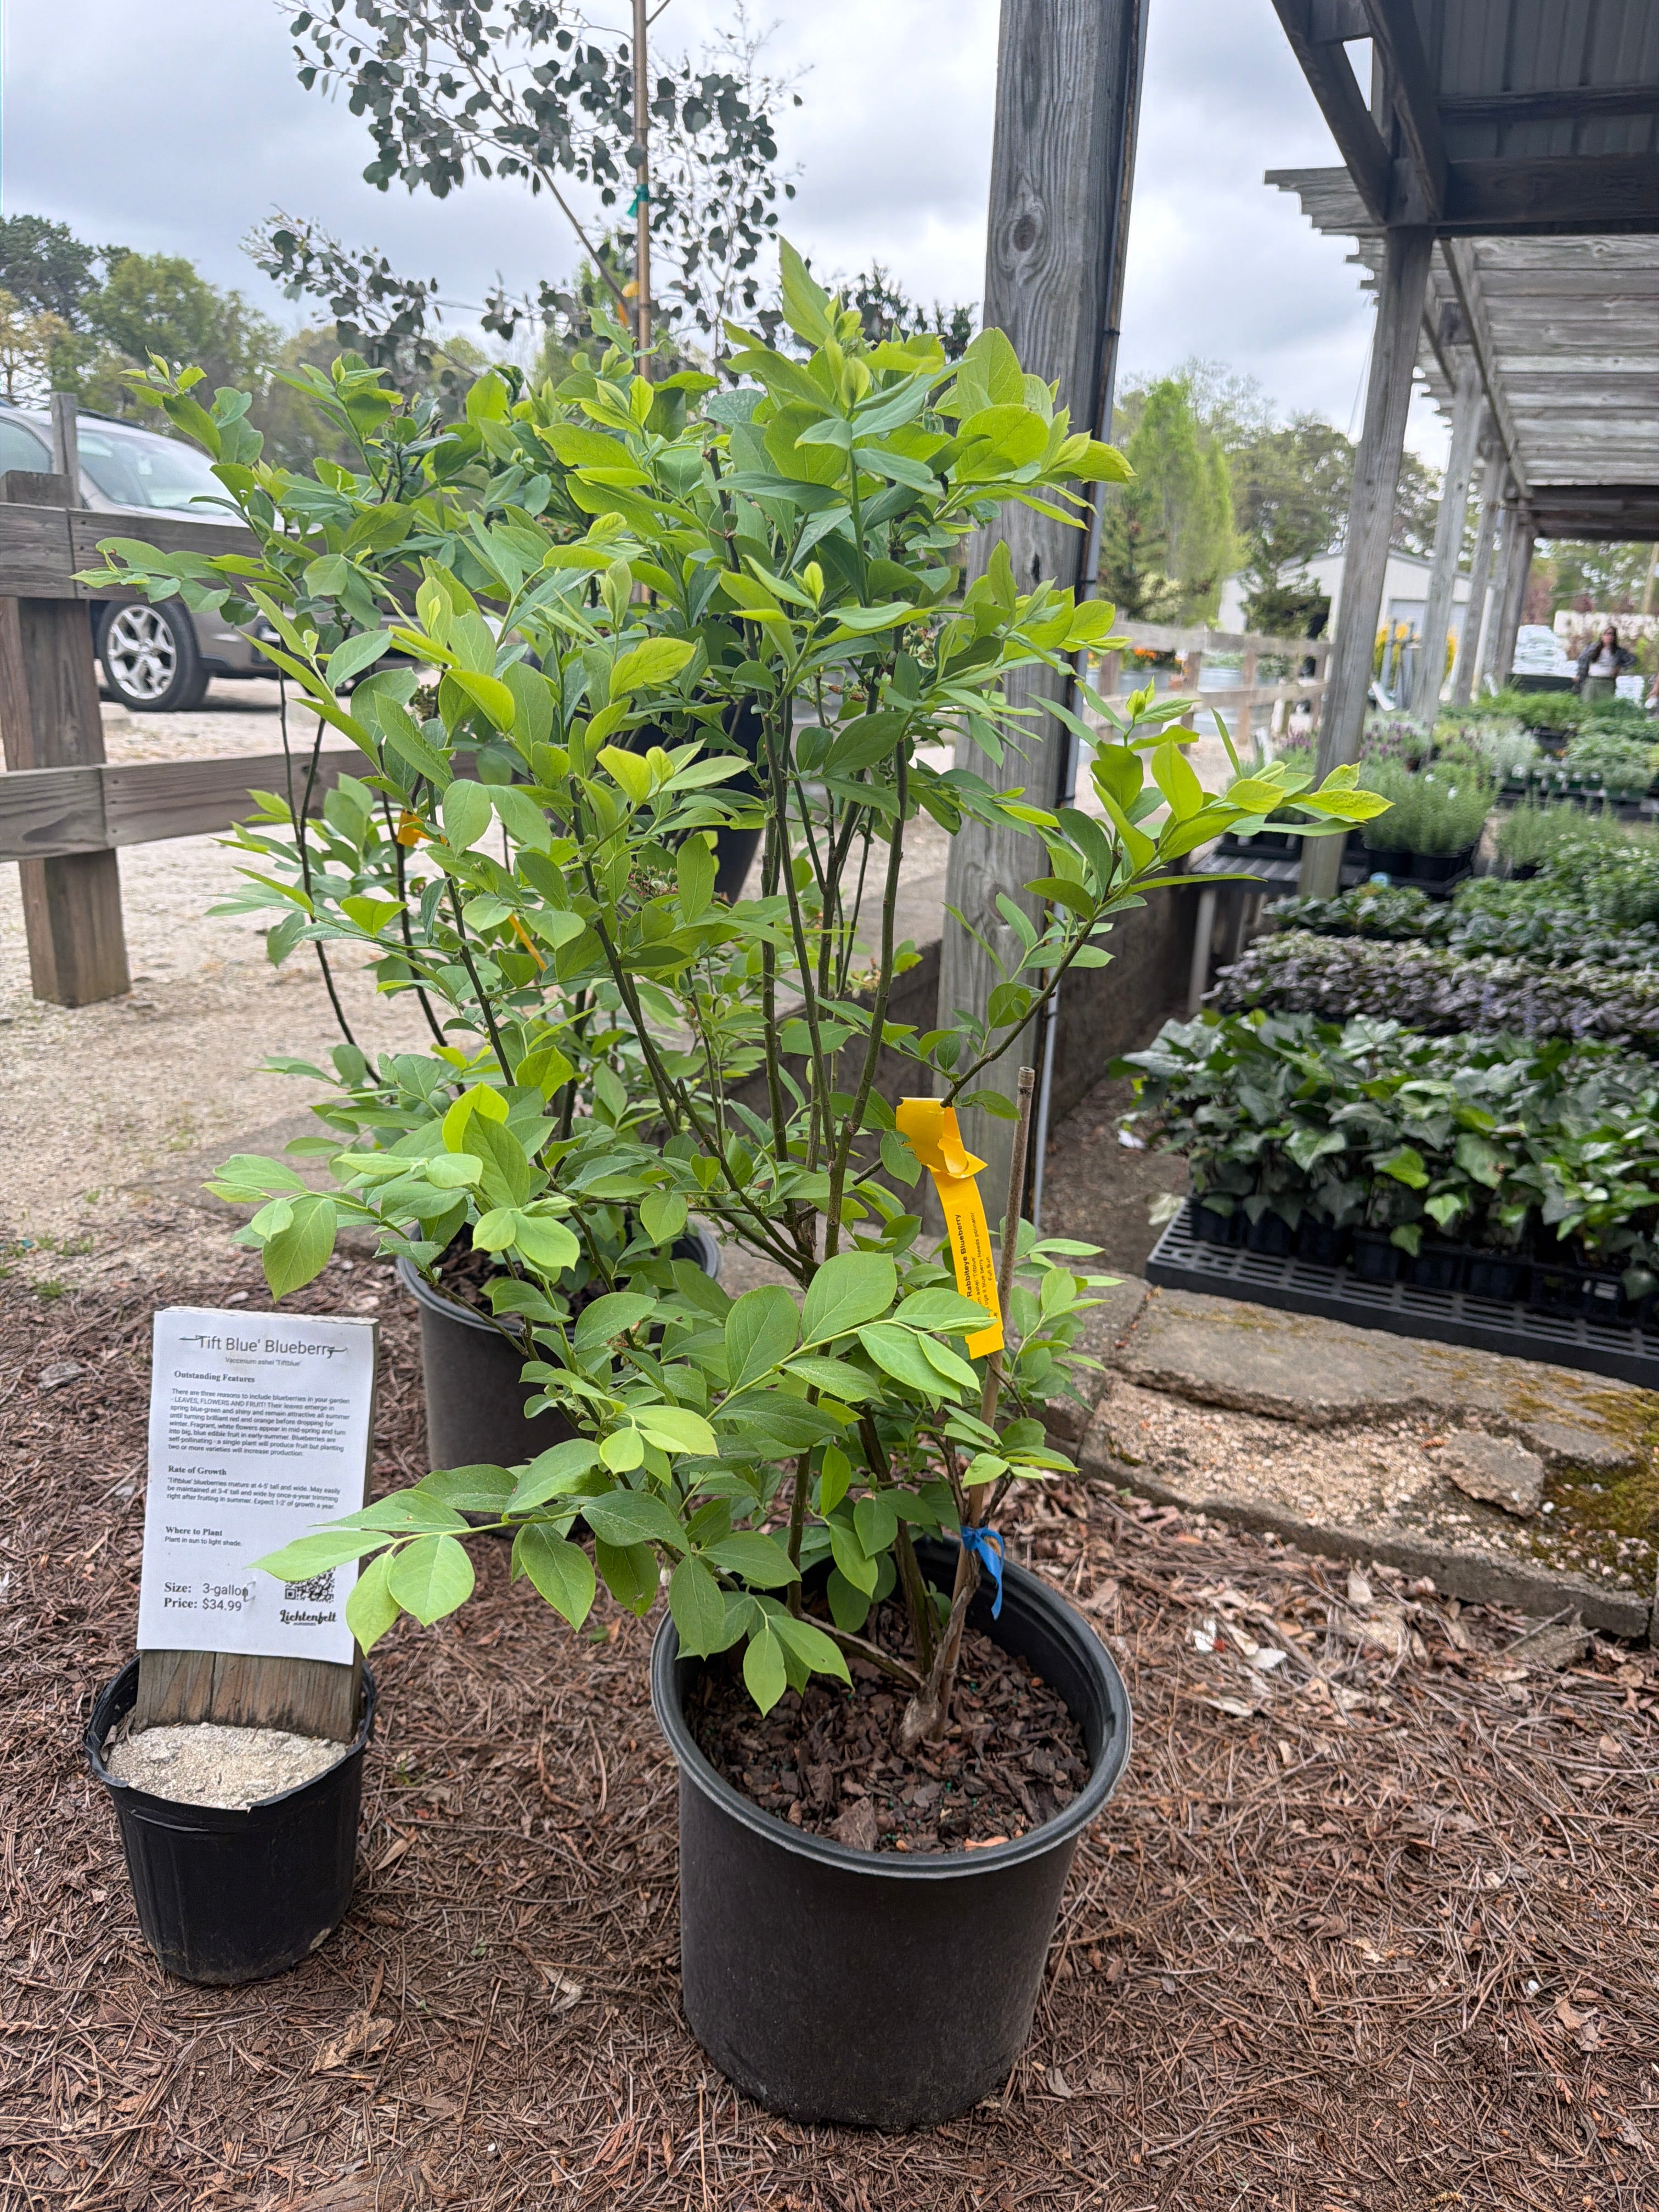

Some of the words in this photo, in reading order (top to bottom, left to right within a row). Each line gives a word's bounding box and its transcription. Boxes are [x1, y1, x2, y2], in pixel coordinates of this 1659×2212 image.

[955, 1214, 966, 1254] Blueberry
[964, 1256, 973, 1297] Rabbiteye
[195, 1335, 222, 1350] 'Tift
[226, 1338, 260, 1352] Blue'
[264, 1339, 335, 1358] Blueberry
[174, 1370, 221, 1382] Outstanding
[223, 1374, 255, 1383] Features
[190, 1421, 216, 1429] Fragrant,
[288, 1427, 320, 1435] mid-spring
[296, 1419, 324, 1427] dropping
[168, 1436, 212, 1444] self-pollinating
[320, 1444, 344, 1453] planting
[197, 1467, 227, 1475] Growth
[197, 1494, 218, 1503] fruiting
[312, 1494, 338, 1503] trimming
[164, 1582, 191, 1593] Size:
[163, 1598, 197, 1608] Price:
[202, 1598, 241, 1611] $34.99
[280, 1609, 336, 1624] Lichtenfelt
